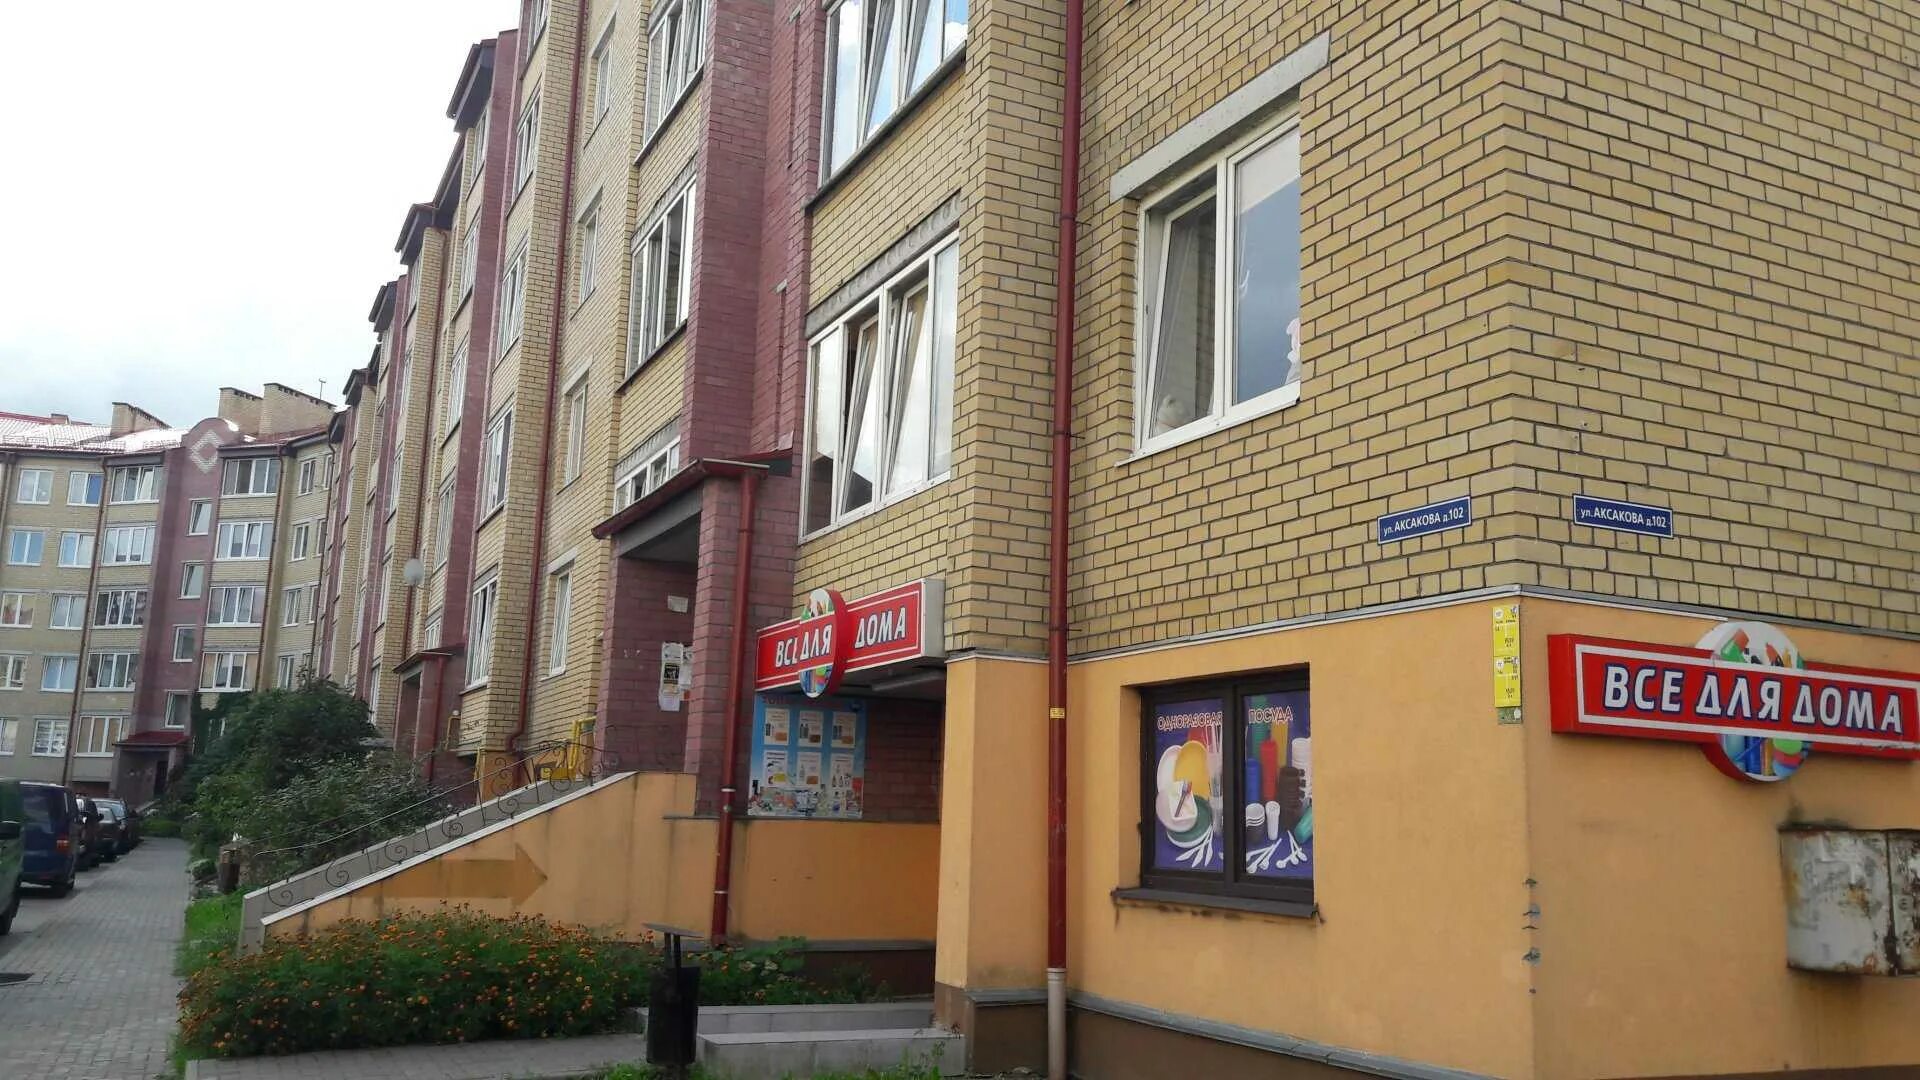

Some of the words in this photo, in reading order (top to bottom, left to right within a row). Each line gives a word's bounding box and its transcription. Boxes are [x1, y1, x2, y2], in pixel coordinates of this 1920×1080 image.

[1394, 512, 1441, 532] АКСАКОВА
[1594, 507, 1644, 525] АКСАКОВА
[800, 624, 832, 660] ДЛЯ
[854, 606, 907, 649] ДОМА
[1603, 665, 1685, 713] ВСЕ
[1695, 673, 1782, 721] ДЛЯ
[1791, 683, 1904, 734] ДОМА
[1157, 710, 1223, 732] ОДНОРАЗОВАЯ
[1248, 705, 1294, 726] ПОСУДА
